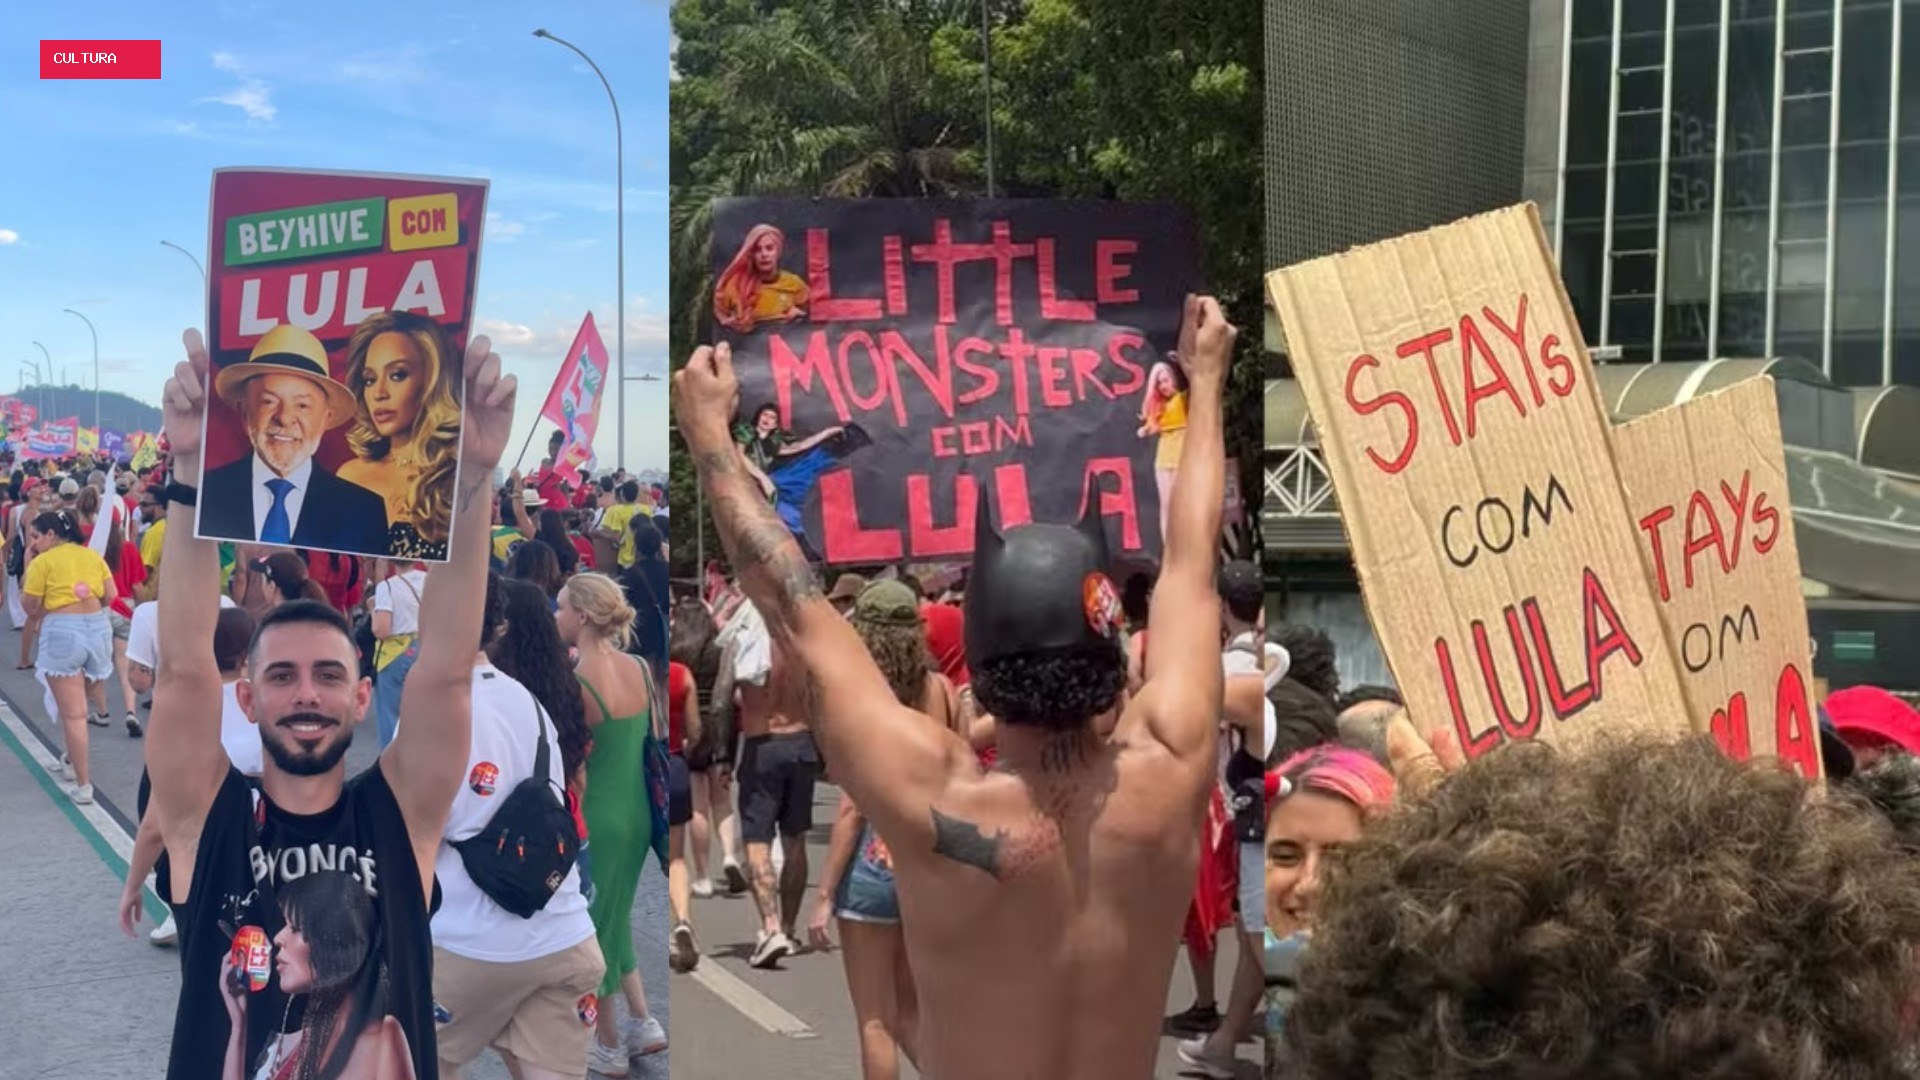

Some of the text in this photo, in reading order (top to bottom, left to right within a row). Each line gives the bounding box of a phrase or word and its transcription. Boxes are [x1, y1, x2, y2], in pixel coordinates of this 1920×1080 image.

[238, 207, 446, 256] BEYHIVE COM
[238, 259, 446, 336] LULA
[931, 415, 1034, 457] COM
[1442, 473, 1575, 568] COM
[1435, 565, 1643, 760] LULA
[1681, 604, 1759, 673] OM
